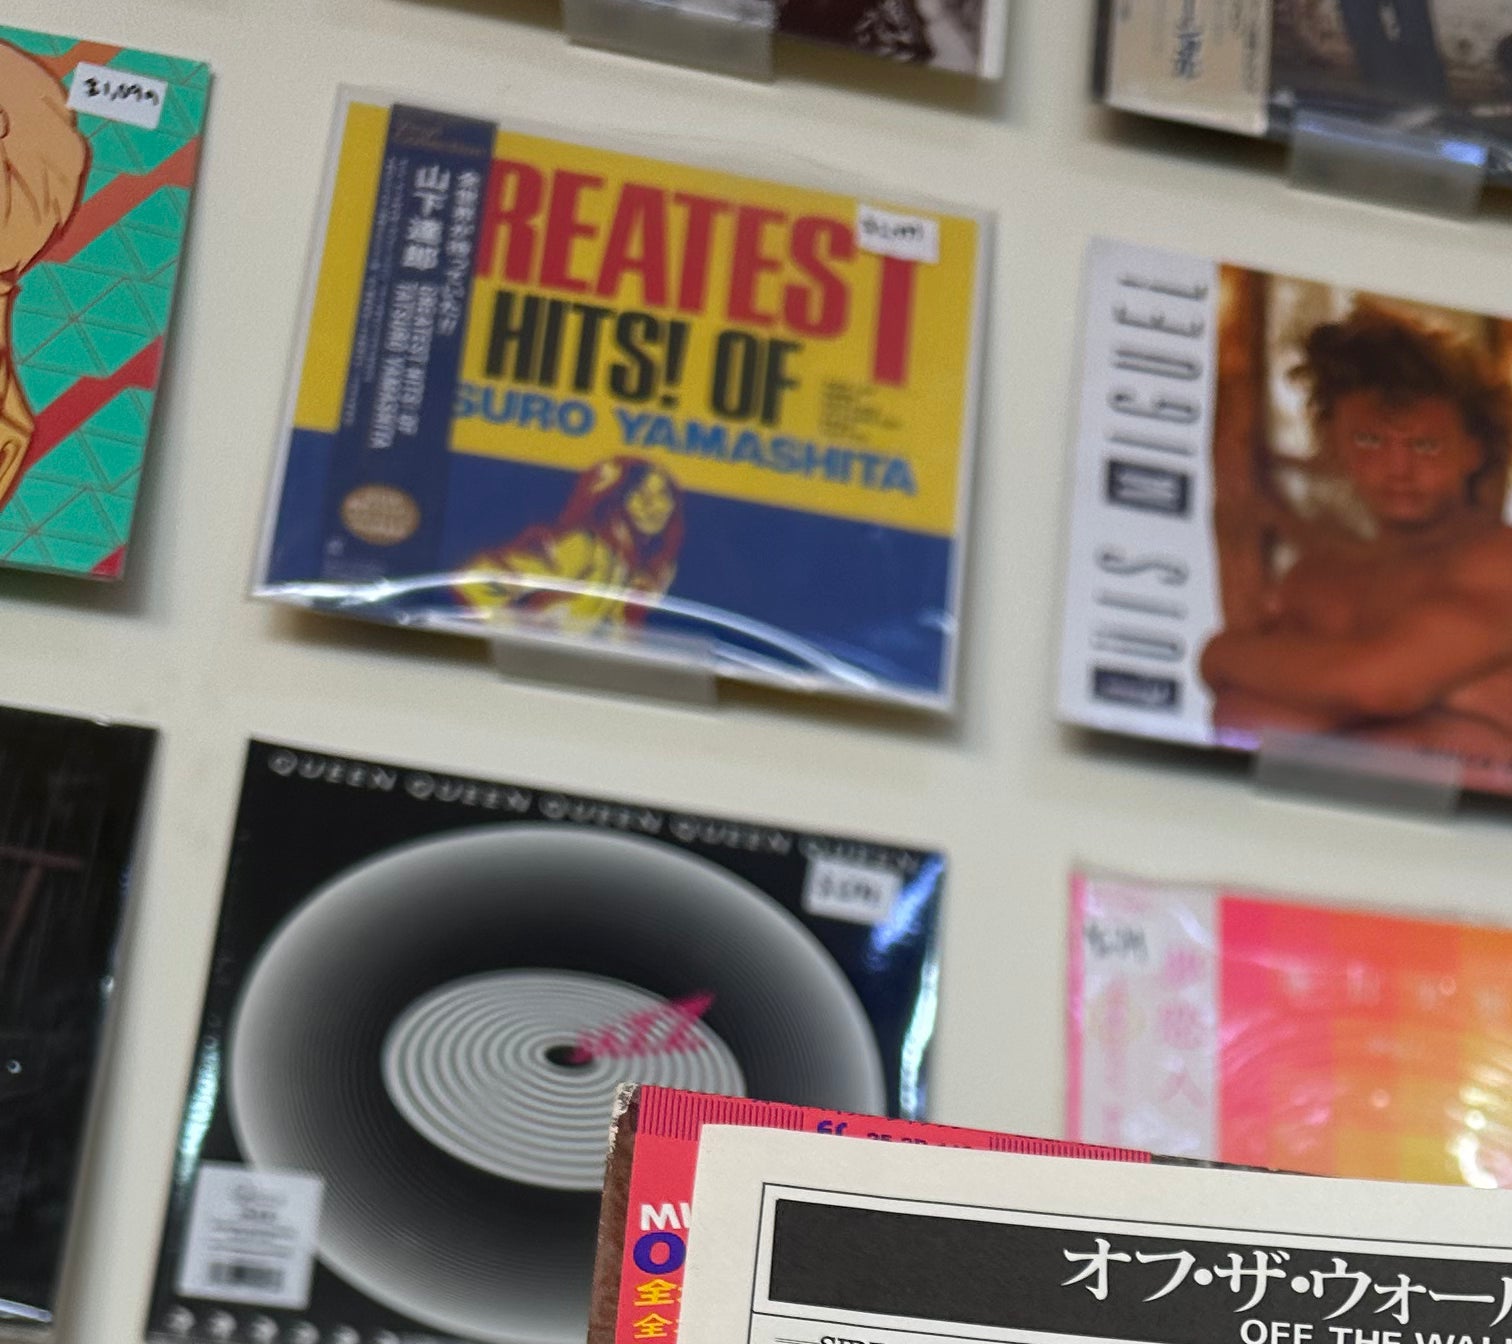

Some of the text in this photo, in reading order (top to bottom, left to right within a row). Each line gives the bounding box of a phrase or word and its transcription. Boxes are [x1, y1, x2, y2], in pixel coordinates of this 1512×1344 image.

[483, 288, 692, 409] HITS!
[710, 329, 804, 428] OF
[613, 405, 918, 496] YAMASHITA
[267, 747, 397, 792] QUEEN
[403, 769, 531, 814] QUEEN
